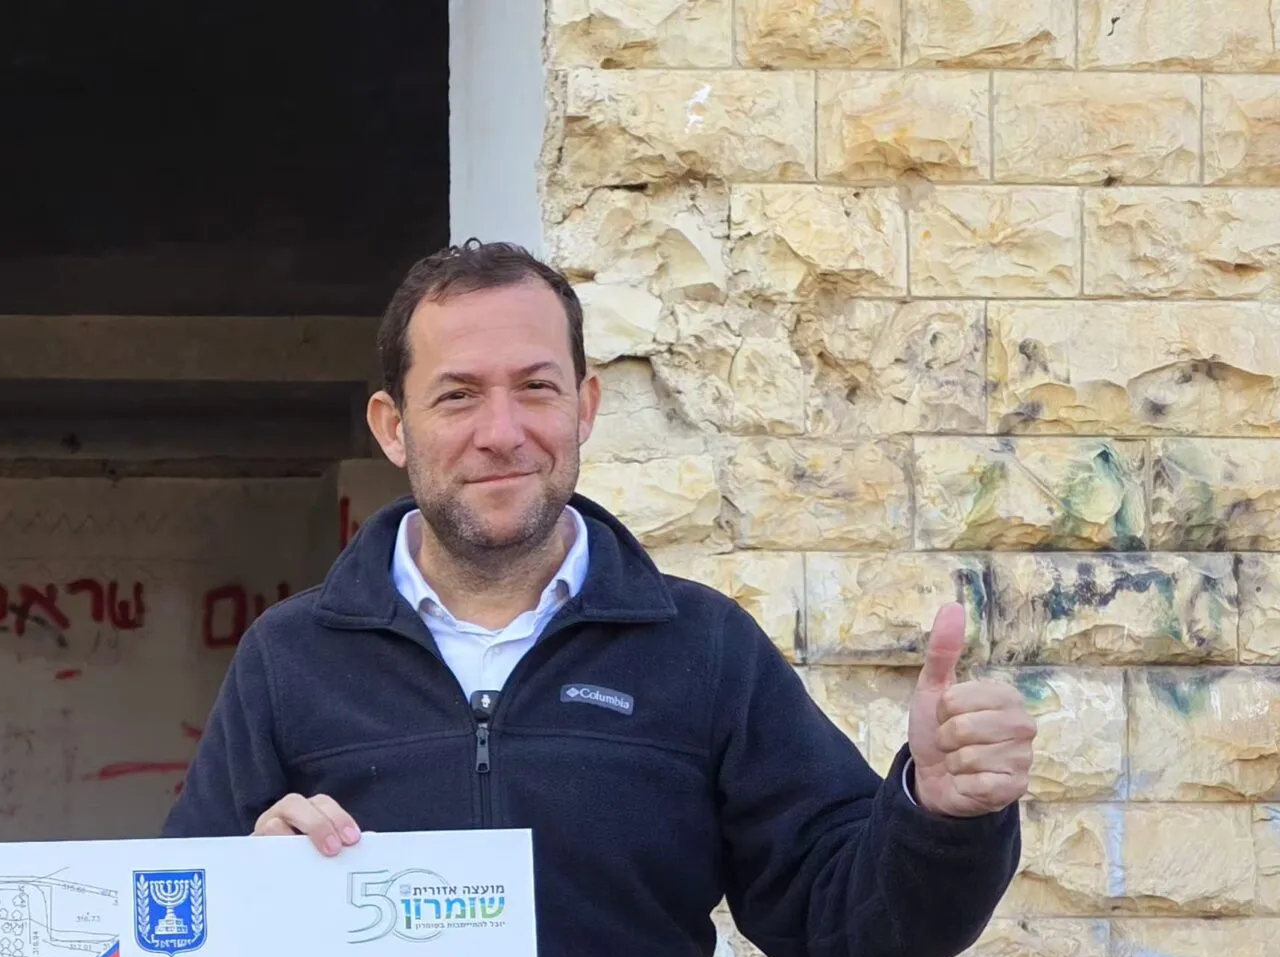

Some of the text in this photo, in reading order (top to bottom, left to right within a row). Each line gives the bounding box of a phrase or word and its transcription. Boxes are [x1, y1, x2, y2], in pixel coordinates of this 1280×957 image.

[579, 687, 630, 709] Columbia
[412, 883, 505, 896] מועצה אזורית
[400, 895, 506, 930] שומרון
[151, 933, 192, 948] ישראל
